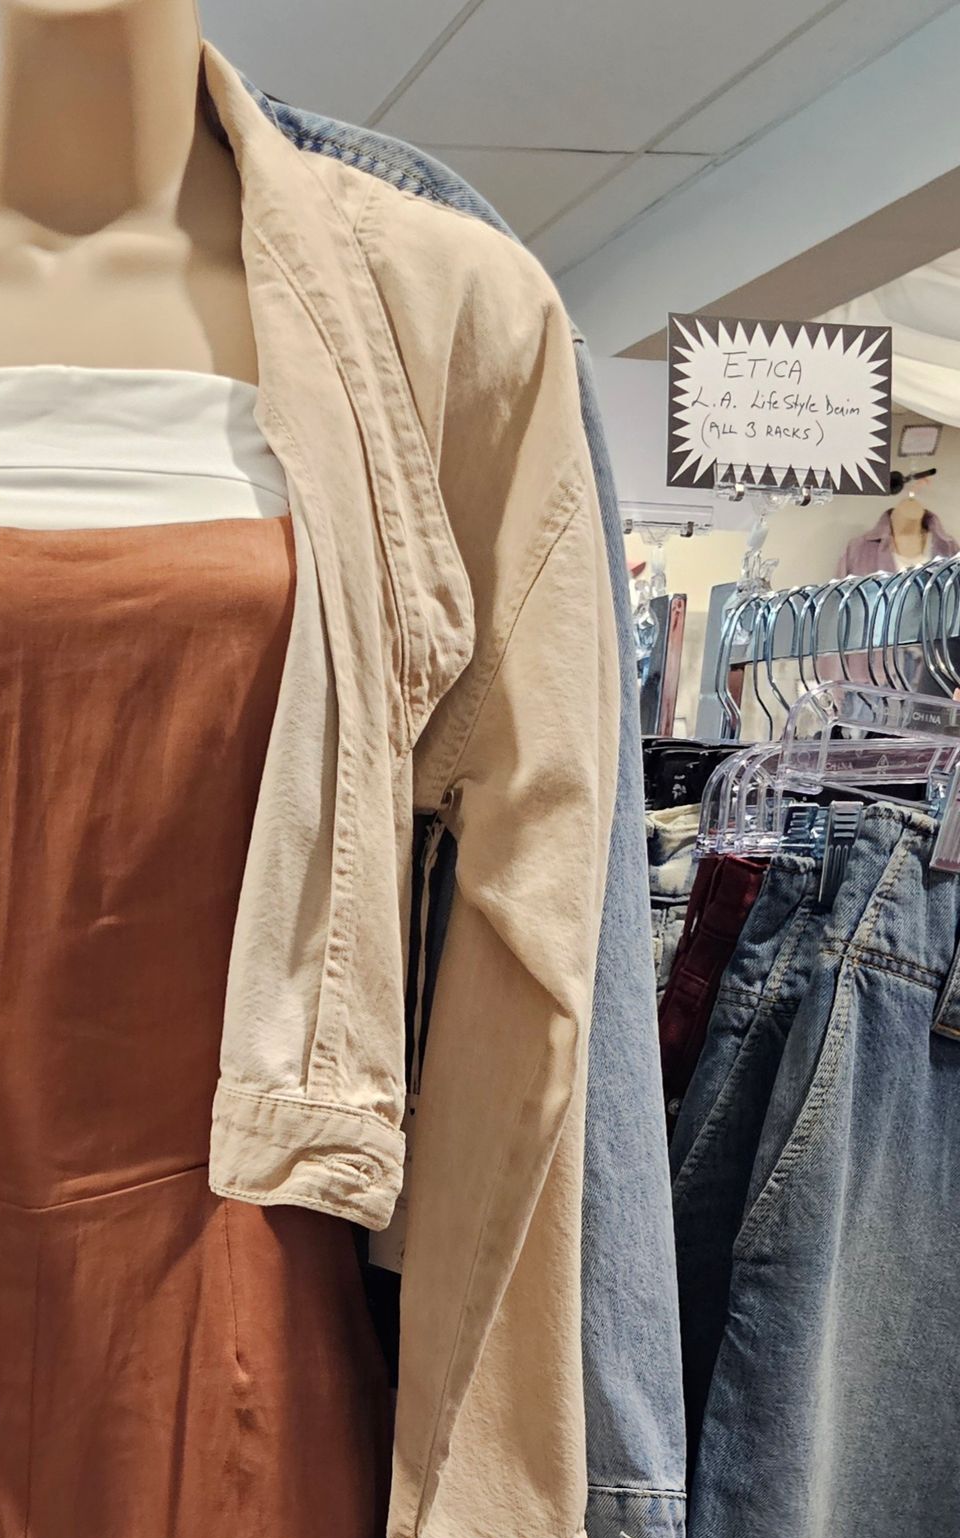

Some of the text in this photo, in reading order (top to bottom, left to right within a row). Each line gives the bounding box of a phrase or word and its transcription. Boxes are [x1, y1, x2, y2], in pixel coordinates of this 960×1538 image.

[722, 351, 803, 385] ETICA
[691, 386, 737, 409] L.A.
[701, 412, 738, 448] (ALL
[744, 421, 757, 438] 3
[912, 711, 941, 725] CHINA
